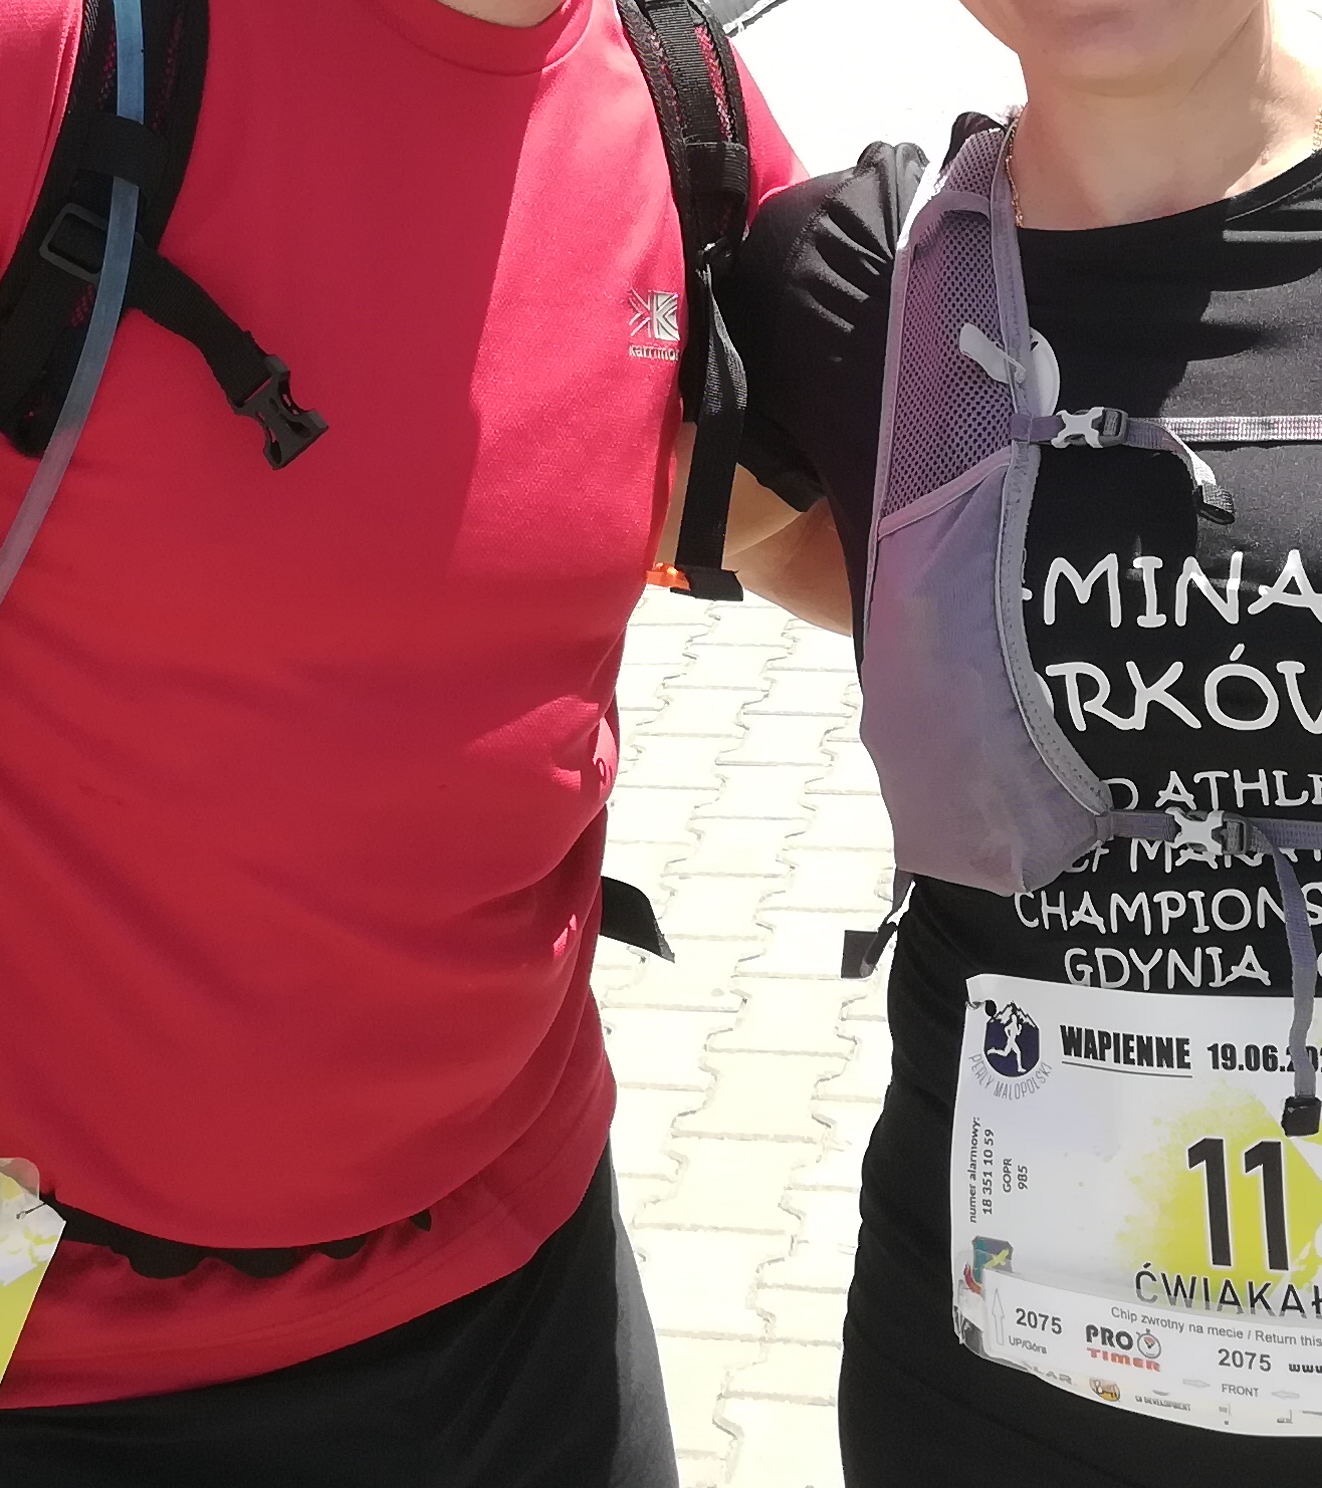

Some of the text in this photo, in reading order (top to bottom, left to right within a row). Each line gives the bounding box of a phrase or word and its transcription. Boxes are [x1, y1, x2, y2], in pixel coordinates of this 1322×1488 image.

[1064, 944, 1271, 991] GDYNIA
[1059, 1024, 1192, 1070] WAPIENNE
[982, 1128, 995, 1215] 18 351 10 59
[1002, 1158, 1013, 1193] GOPR
[1017, 1164, 1029, 1190] 985
[969, 1188, 978, 1224] numer
[1187, 1137, 1290, 1271] 11
[1015, 1308, 1063, 1335] 2075
[1085, 1323, 1134, 1350] PRO
[1218, 1348, 1272, 1373] 2075
[1111, 1306, 1138, 1323] Chip
[1141, 1313, 1185, 1334] zwrotny
[1188, 1323, 1204, 1334] na
[1207, 1324, 1244, 1340] mecie
[1255, 1329, 1297, 1347] Return
[1300, 1334, 1322, 1348] this
[1221, 1384, 1259, 1398] FRONT
